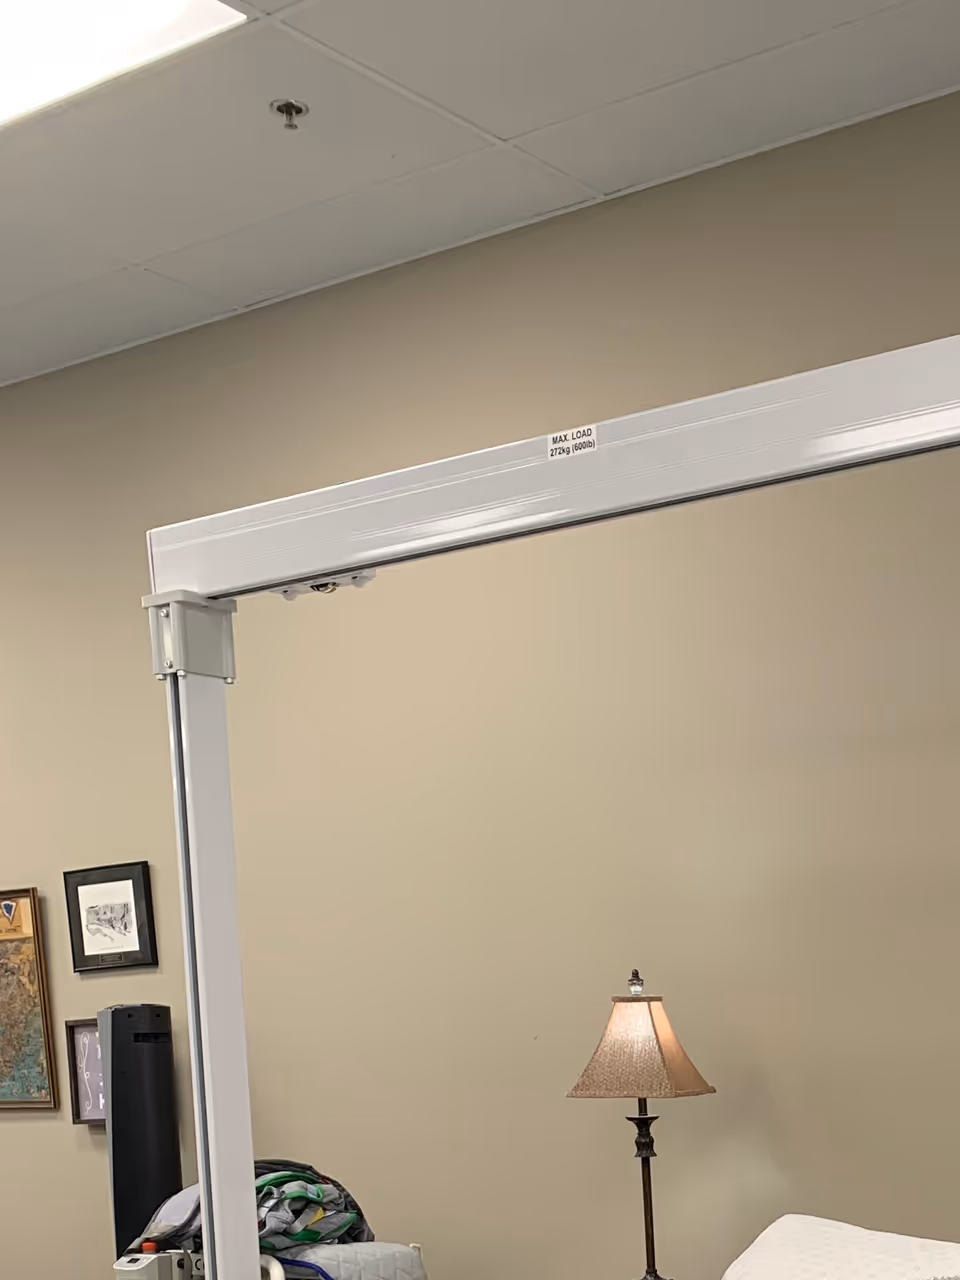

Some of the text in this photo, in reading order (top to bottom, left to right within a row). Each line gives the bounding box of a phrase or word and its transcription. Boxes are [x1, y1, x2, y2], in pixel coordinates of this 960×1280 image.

[552, 428, 592, 444] MAX. LOAD
[550, 439, 595, 457] 272kg (600lb)
